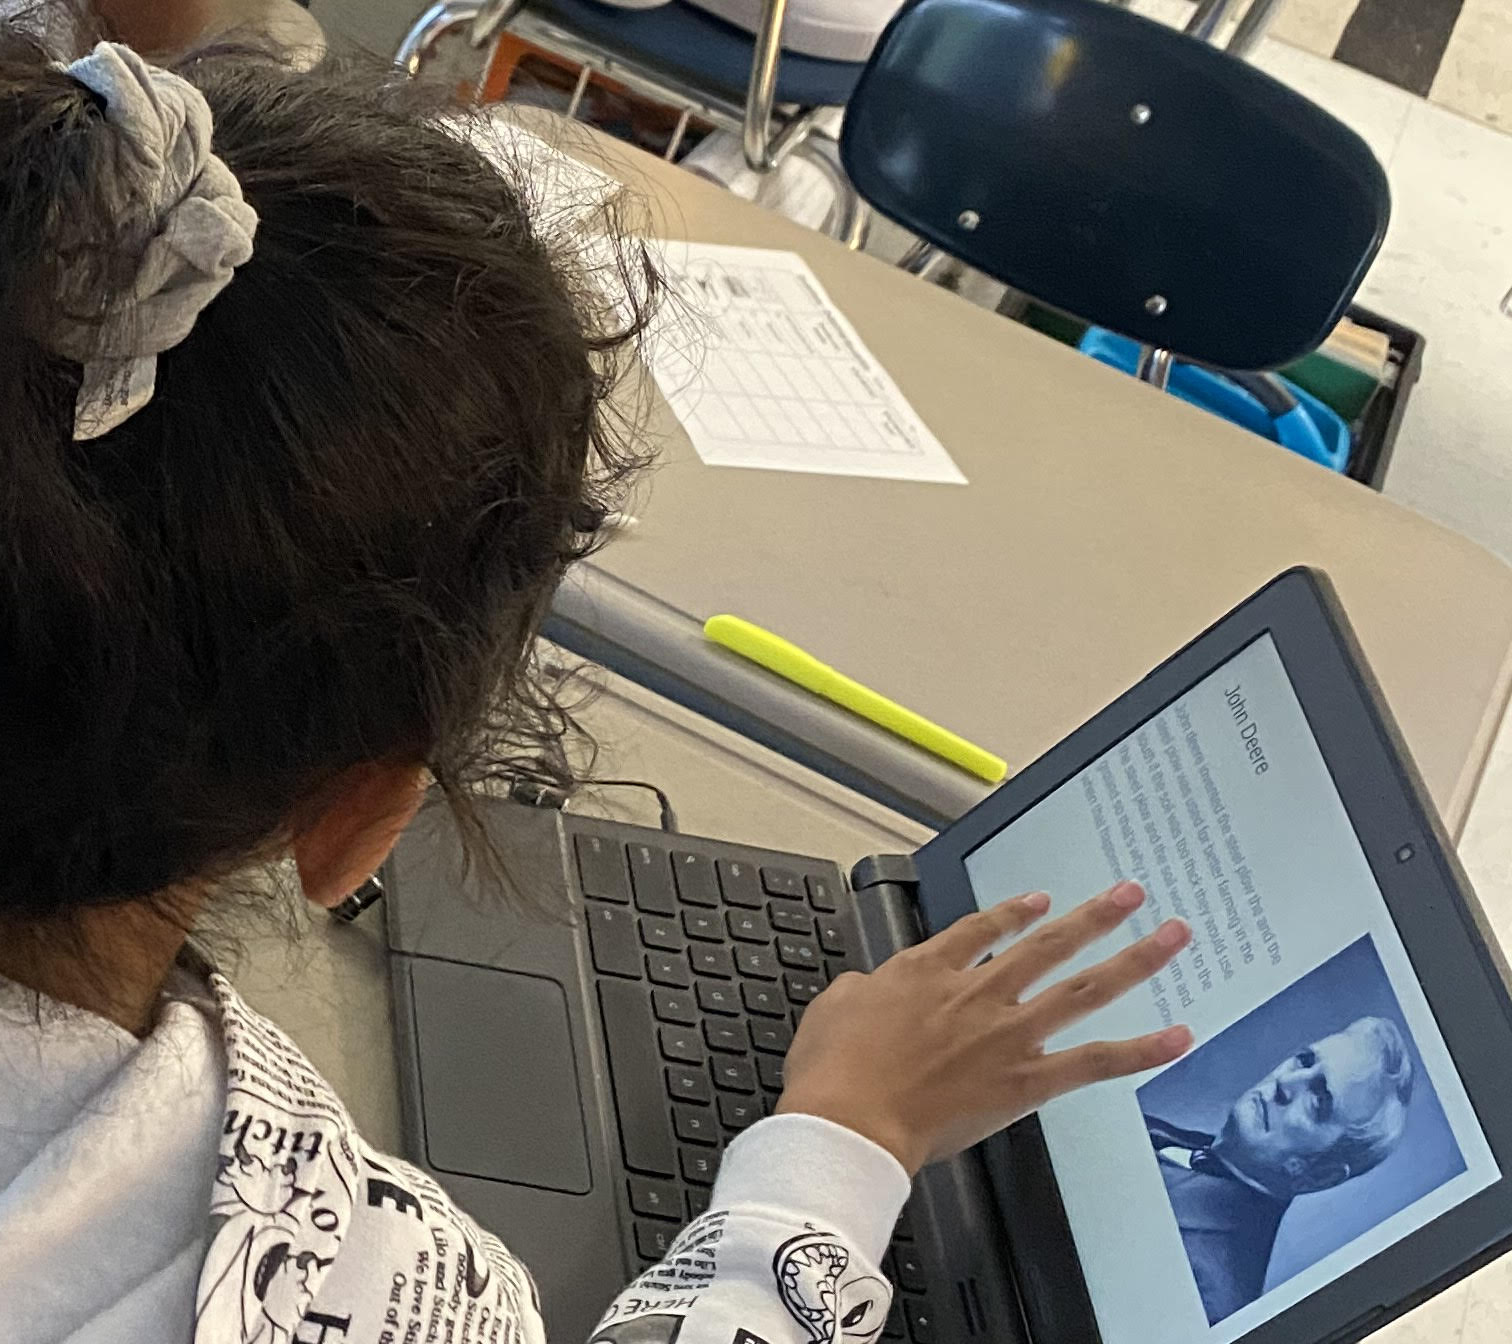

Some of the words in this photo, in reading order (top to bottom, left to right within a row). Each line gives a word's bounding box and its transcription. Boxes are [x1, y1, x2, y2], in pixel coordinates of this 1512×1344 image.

[1220, 684, 1253, 727] John
[1236, 723, 1271, 776] Deere
[1252, 916, 1274, 944] and
[1261, 940, 1282, 966] the
[1195, 967, 1216, 993] the
[409, 1247, 435, 1276] We
[385, 1270, 412, 1304] Out
[406, 1277, 434, 1317] love
[382, 1305, 405, 1330] of
